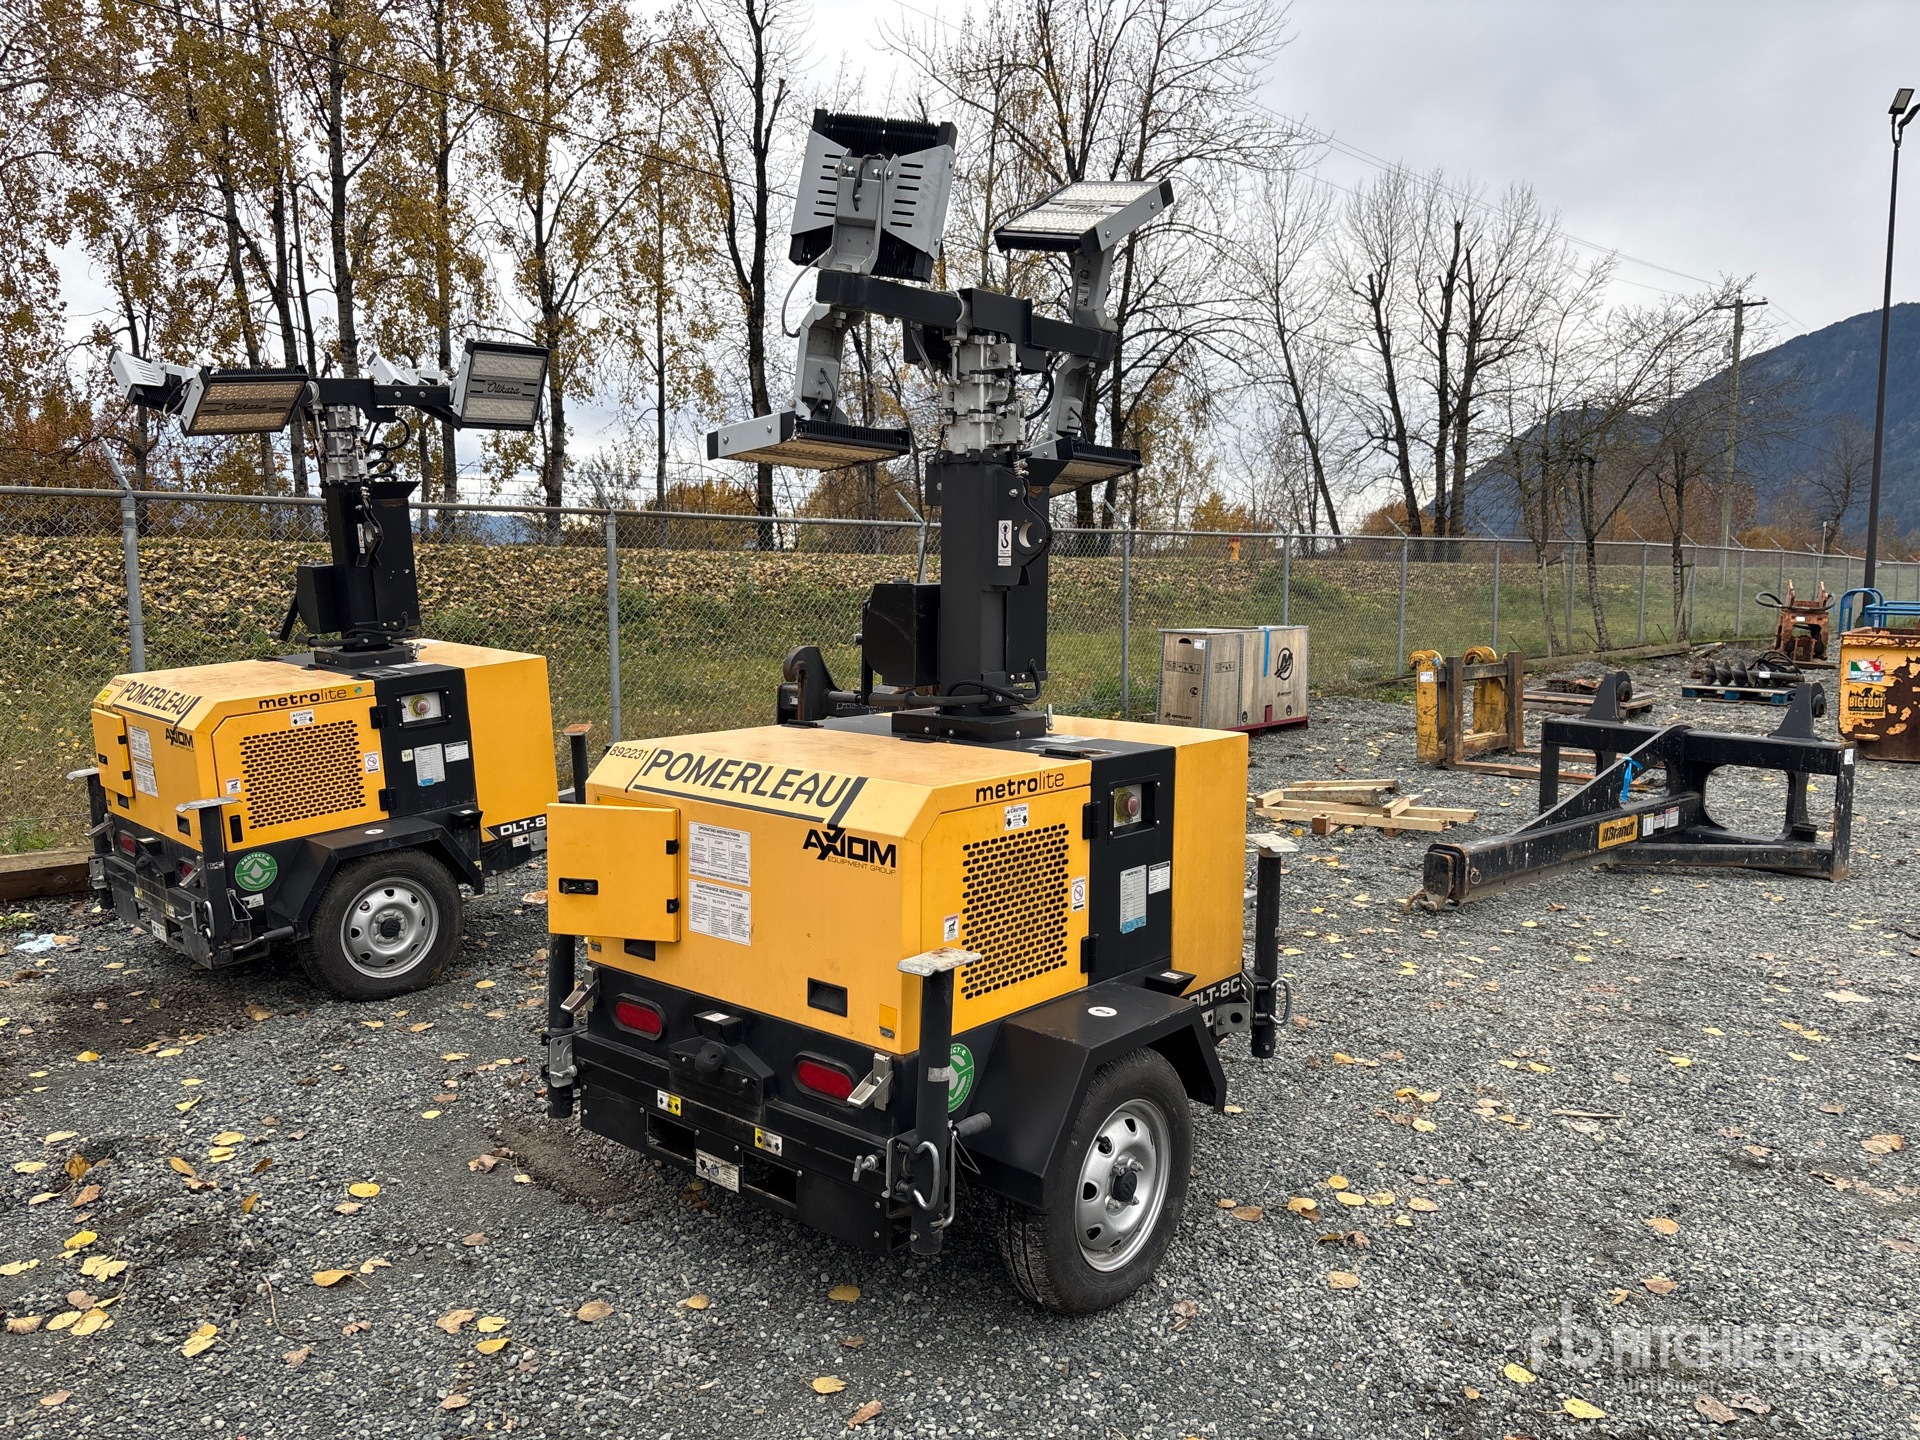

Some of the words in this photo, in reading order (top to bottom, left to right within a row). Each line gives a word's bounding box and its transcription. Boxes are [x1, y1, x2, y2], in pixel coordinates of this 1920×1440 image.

[119, 681, 196, 716] POMERLEAU
[258, 688, 347, 709] metrolite
[1850, 697, 1883, 708] BIGFOOT
[165, 726, 194, 748] AXIOM
[609, 745, 648, 761] 892231
[642, 748, 852, 808] POMERLEAU
[976, 771, 1065, 803] metrolite
[1607, 821, 1635, 840] Brandt
[802, 826, 896, 868] AXIOM
[827, 856, 868, 870] EQUIPMENT
[869, 864, 896, 876] GROUP
